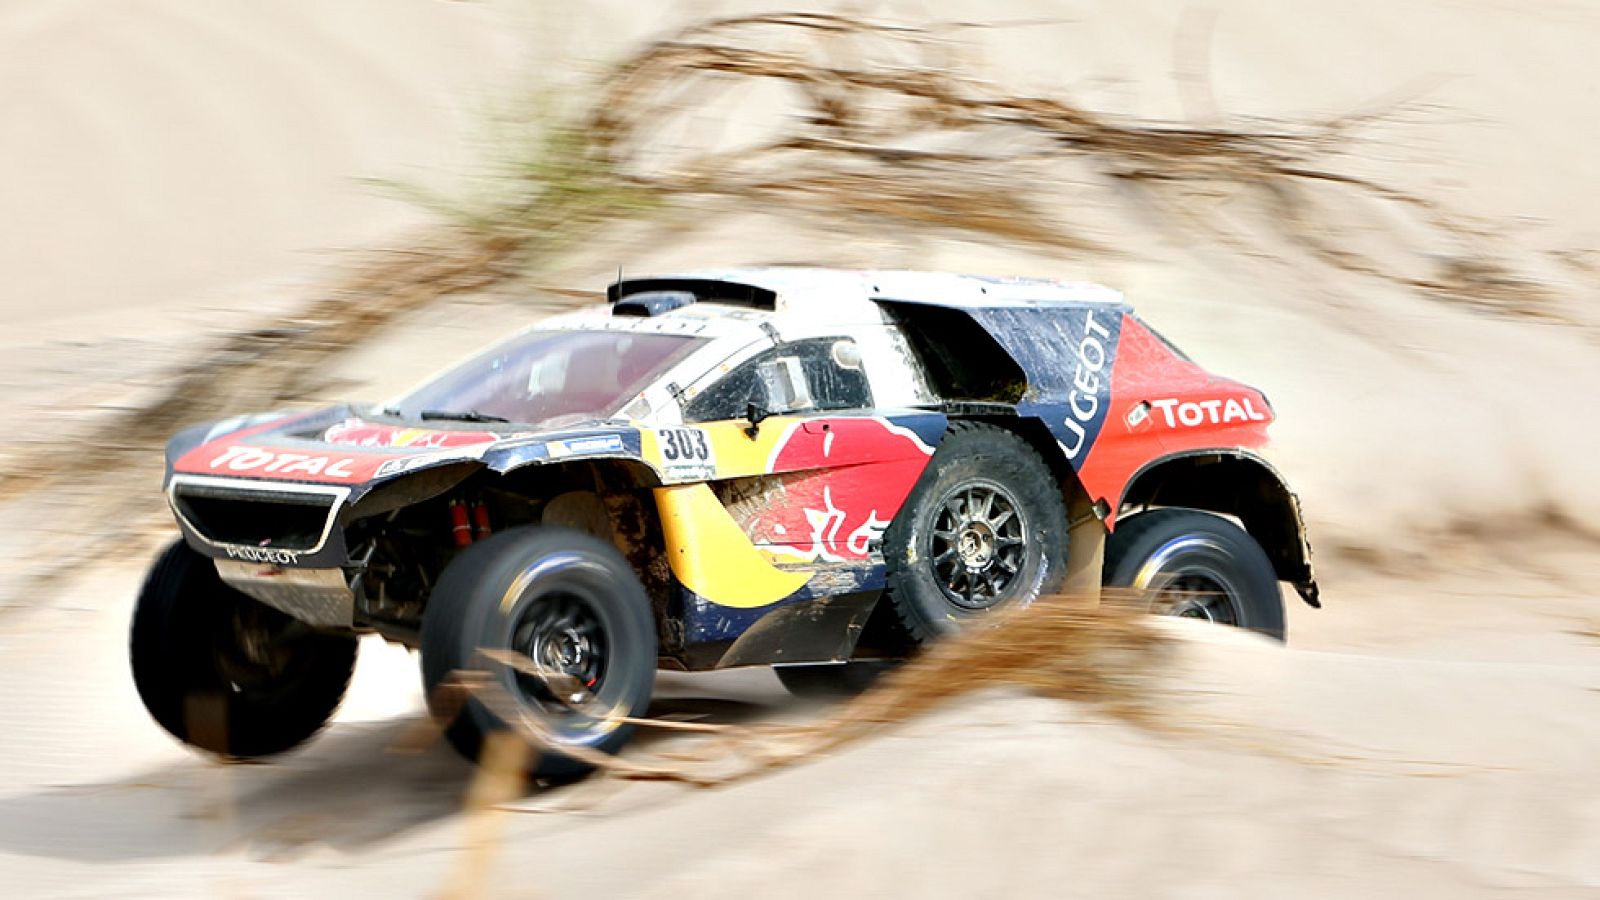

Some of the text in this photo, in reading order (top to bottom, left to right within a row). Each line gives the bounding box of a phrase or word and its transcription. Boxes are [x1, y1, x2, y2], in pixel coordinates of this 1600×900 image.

[1152, 398, 1264, 428] TOTAL
[659, 429, 709, 460] 303
[210, 446, 355, 477] TOTAL
